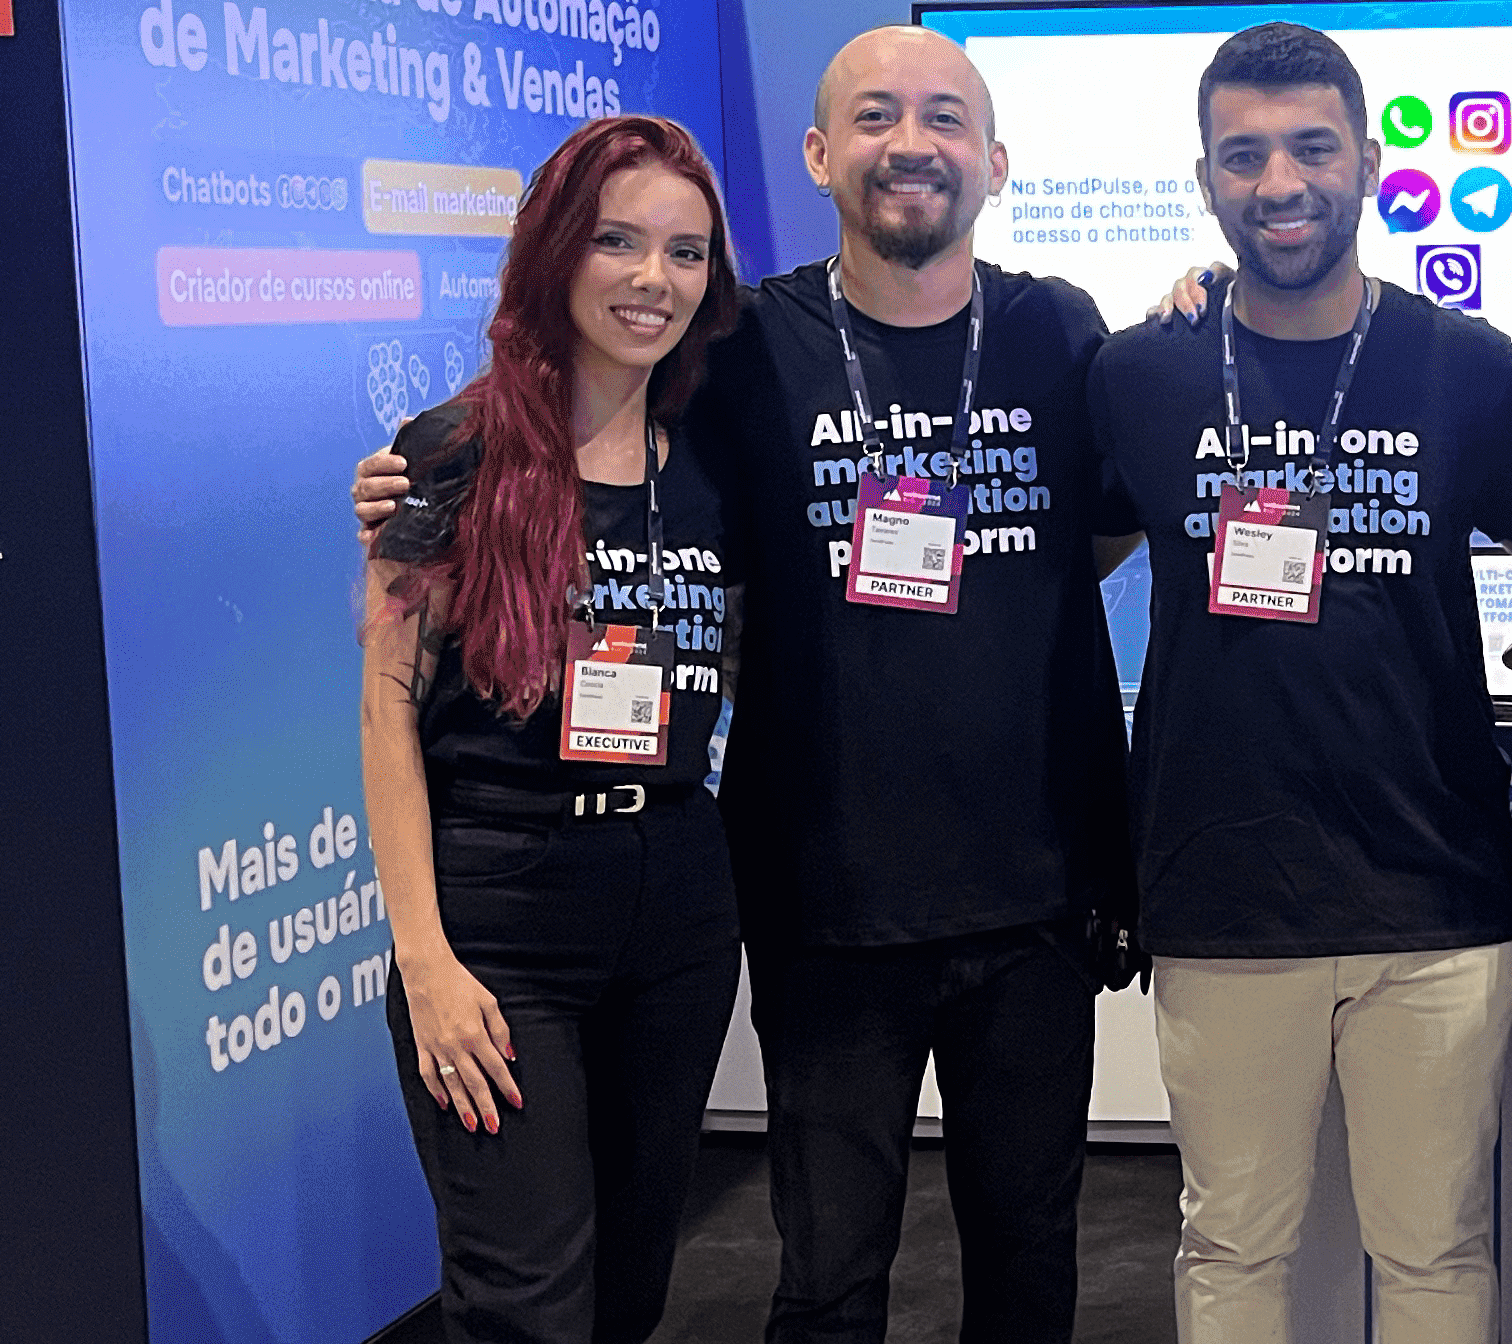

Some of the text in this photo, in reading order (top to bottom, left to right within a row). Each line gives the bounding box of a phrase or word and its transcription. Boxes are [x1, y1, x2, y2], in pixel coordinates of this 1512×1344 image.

[223, 1, 450, 122] Marketing
[462, 42, 491, 105] &
[496, 47, 620, 118] Vendas
[162, 165, 519, 225] Chatbots E-mail marketing
[1011, 179, 1036, 195] Na
[1042, 176, 1149, 196] SendPulse,
[1155, 179, 1178, 194] ao
[1012, 203, 1064, 223] plano
[1071, 202, 1093, 219] de
[1099, 201, 1191, 219] chatbots,
[1012, 229, 1081, 243] acesso
[170, 267, 415, 303] Criador de cursos online
[872, 513, 910, 526] Magno
[1234, 526, 1273, 541] Wesley
[870, 580, 933, 598] PARTNER
[1231, 591, 1294, 608] PARTNER
[576, 735, 650, 751] EXECUTIVE
[198, 806, 358, 911] Mais de
[203, 924, 258, 991] de
[206, 985, 306, 1072] todo
[317, 975, 341, 1021] o
